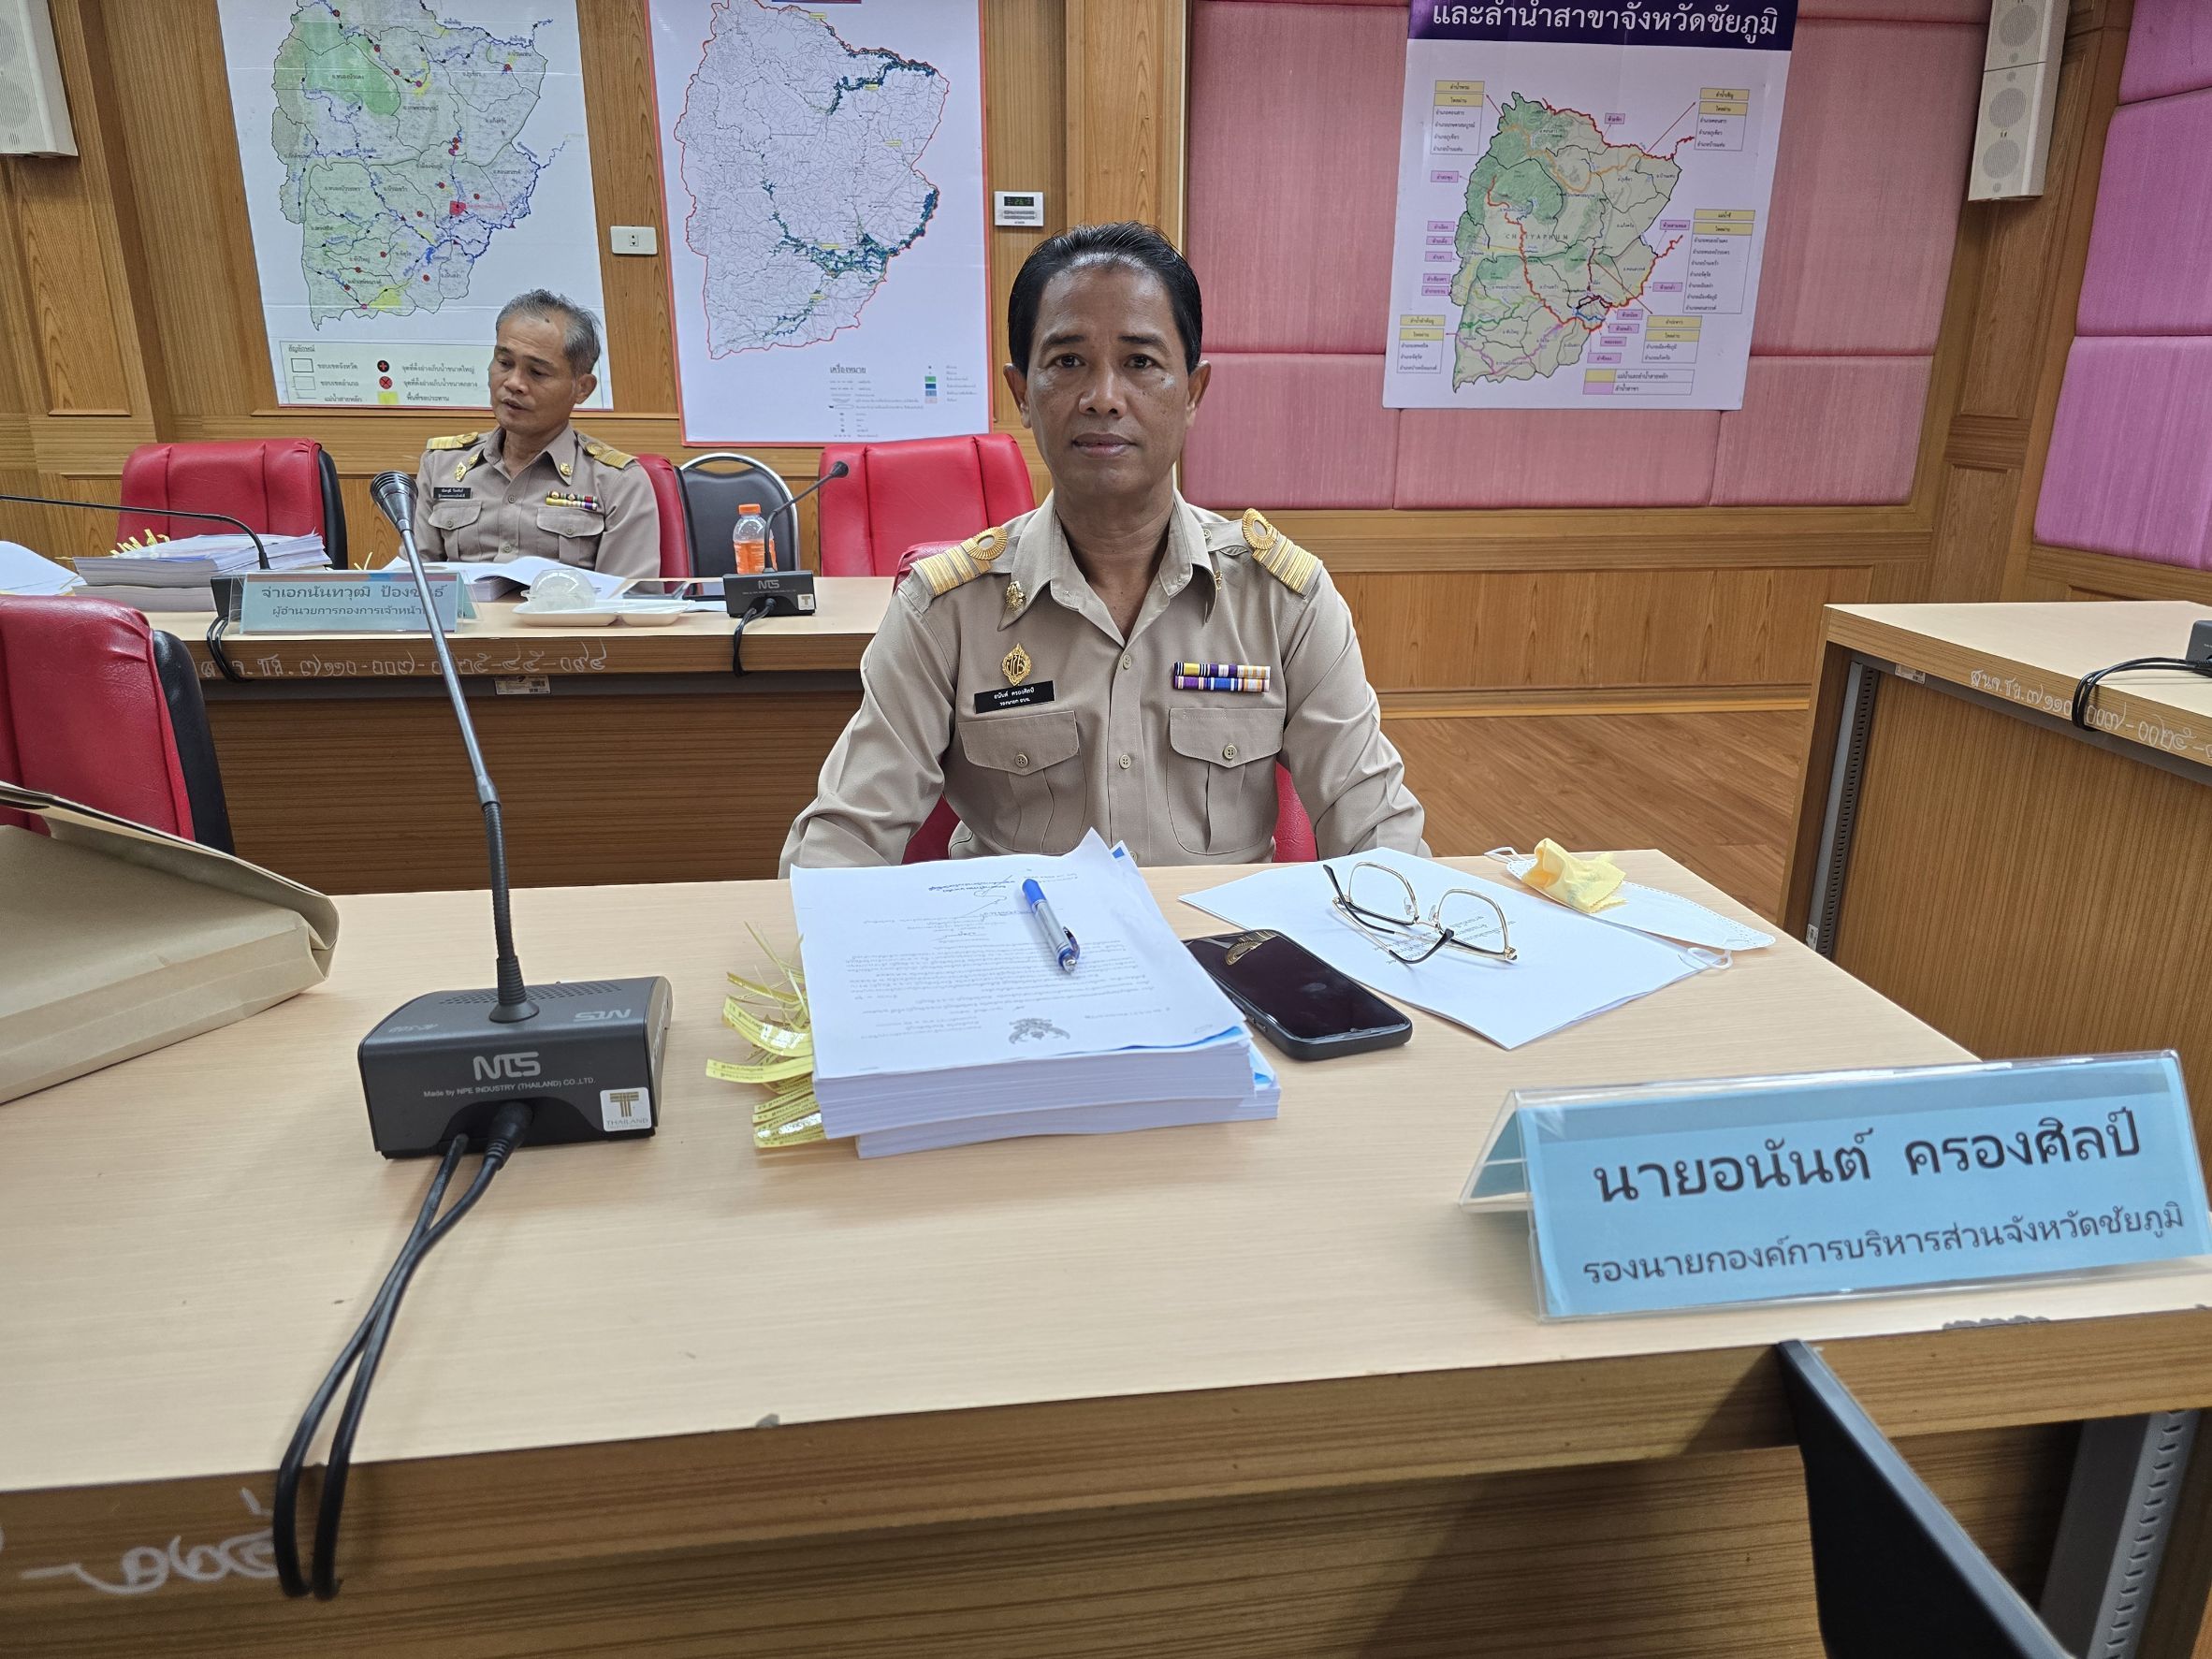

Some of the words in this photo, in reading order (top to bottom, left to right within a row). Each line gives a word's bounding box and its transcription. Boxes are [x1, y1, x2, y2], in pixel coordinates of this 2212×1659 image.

[1433, 0, 1778, 44] และลำนำสาขาจังหวัดชัยภูมิ
[261, 585, 371, 601] จ่าเอกนันทวุฒิ
[381, 584, 448, 598] ป้องขธ์
[473, 1051, 541, 1082] NTS
[445, 1089, 455, 1098] by
[457, 1086, 473, 1095] NPE
[475, 1083, 516, 1094] INDUSTRY
[517, 1079, 562, 1091] (THAILAND)
[1593, 1128, 1875, 1203] นายอนันต์
[1904, 1105, 2142, 1177] ครองศิลป์
[1582, 1200, 2185, 1285] รองนายกองค์การบริหารส่วนจังหวัดชัยภูมิ
